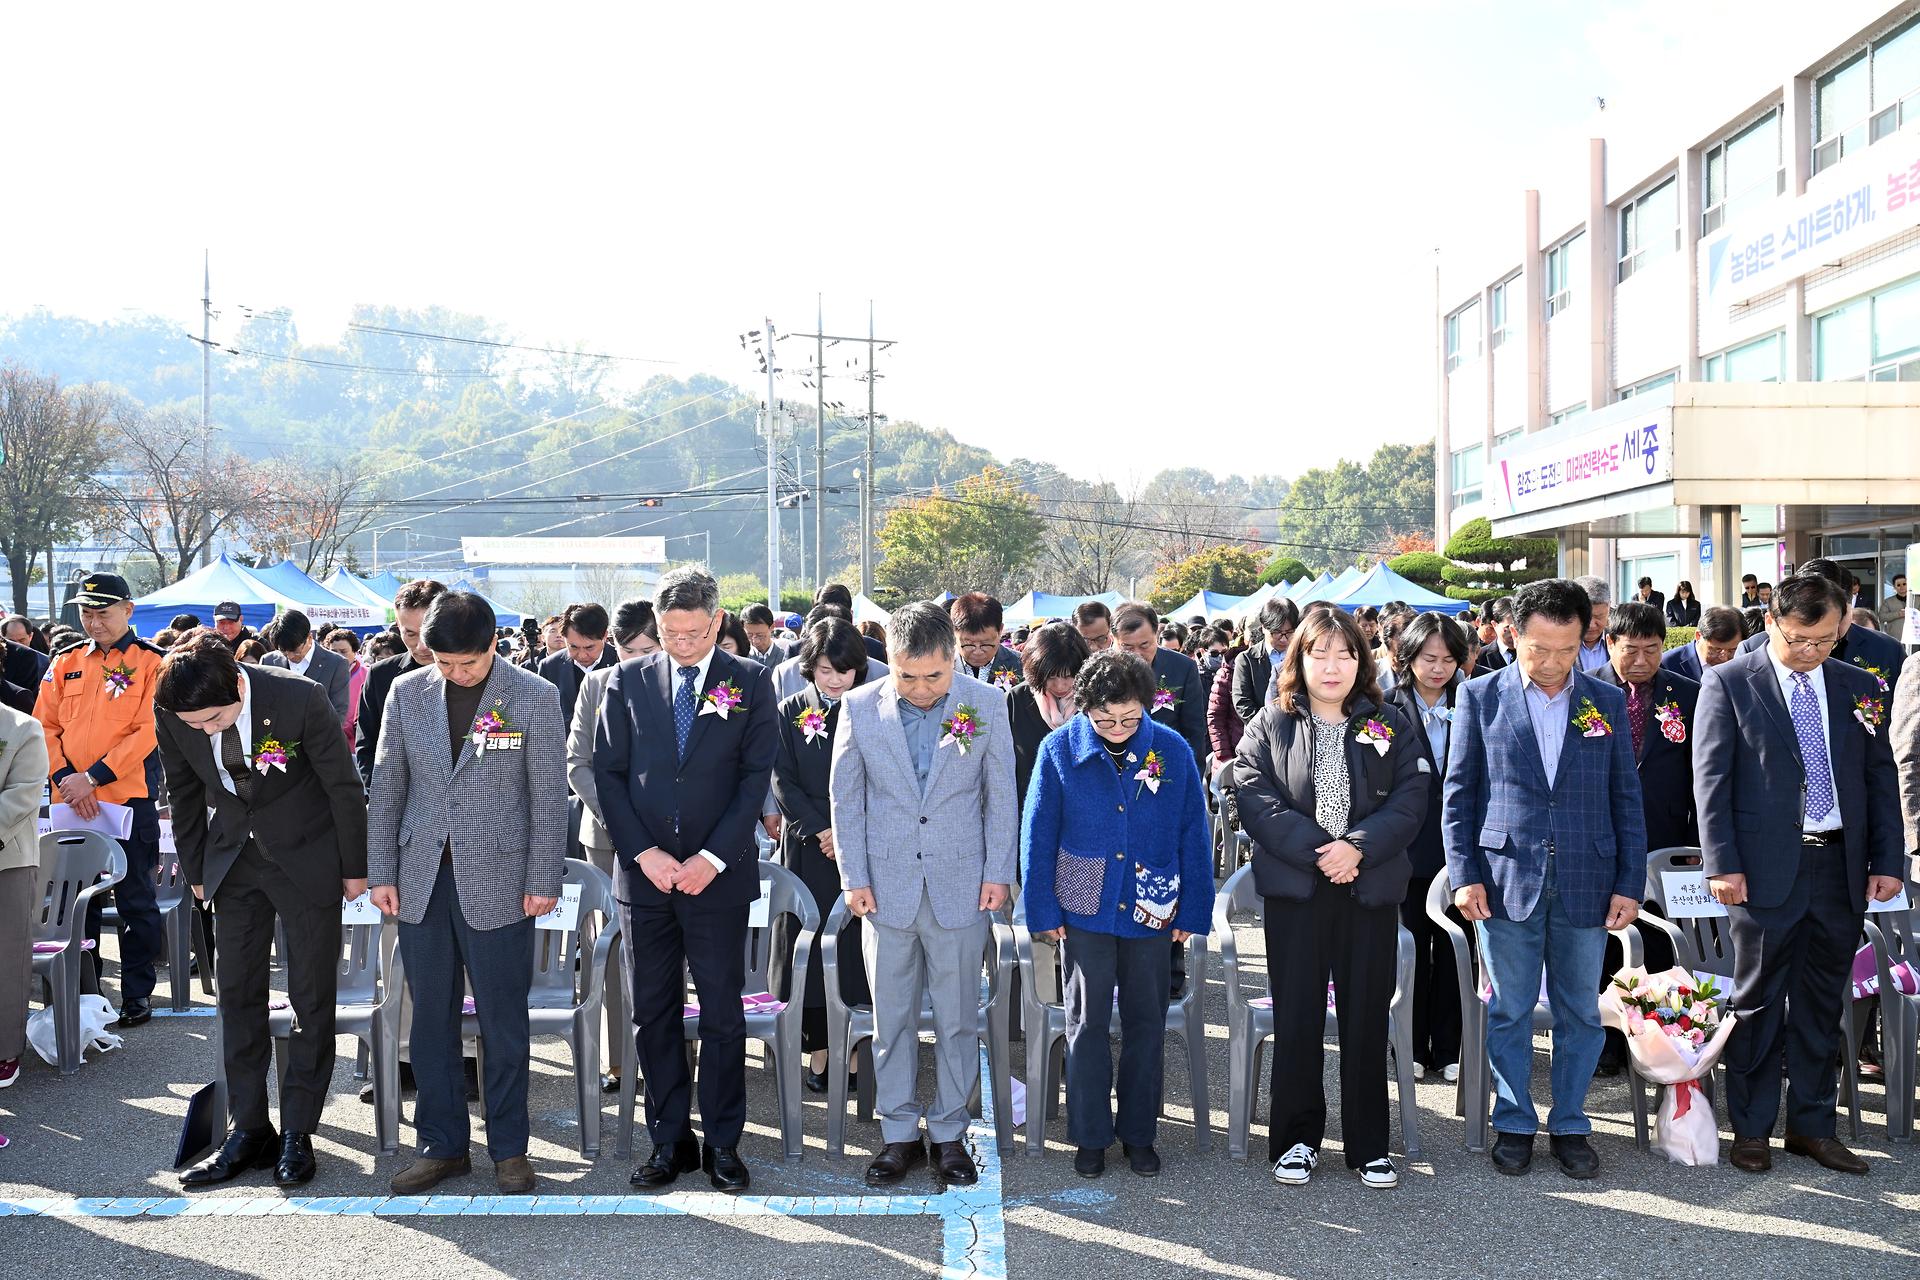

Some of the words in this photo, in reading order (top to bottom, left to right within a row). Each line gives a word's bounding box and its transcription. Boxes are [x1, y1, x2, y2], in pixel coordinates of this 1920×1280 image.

[1730, 232, 1775, 284] 농업은
[1781, 184, 1876, 261] 스마트하게,
[1566, 444, 1619, 483] 미래전략수도
[1622, 423, 1659, 475] 세종
